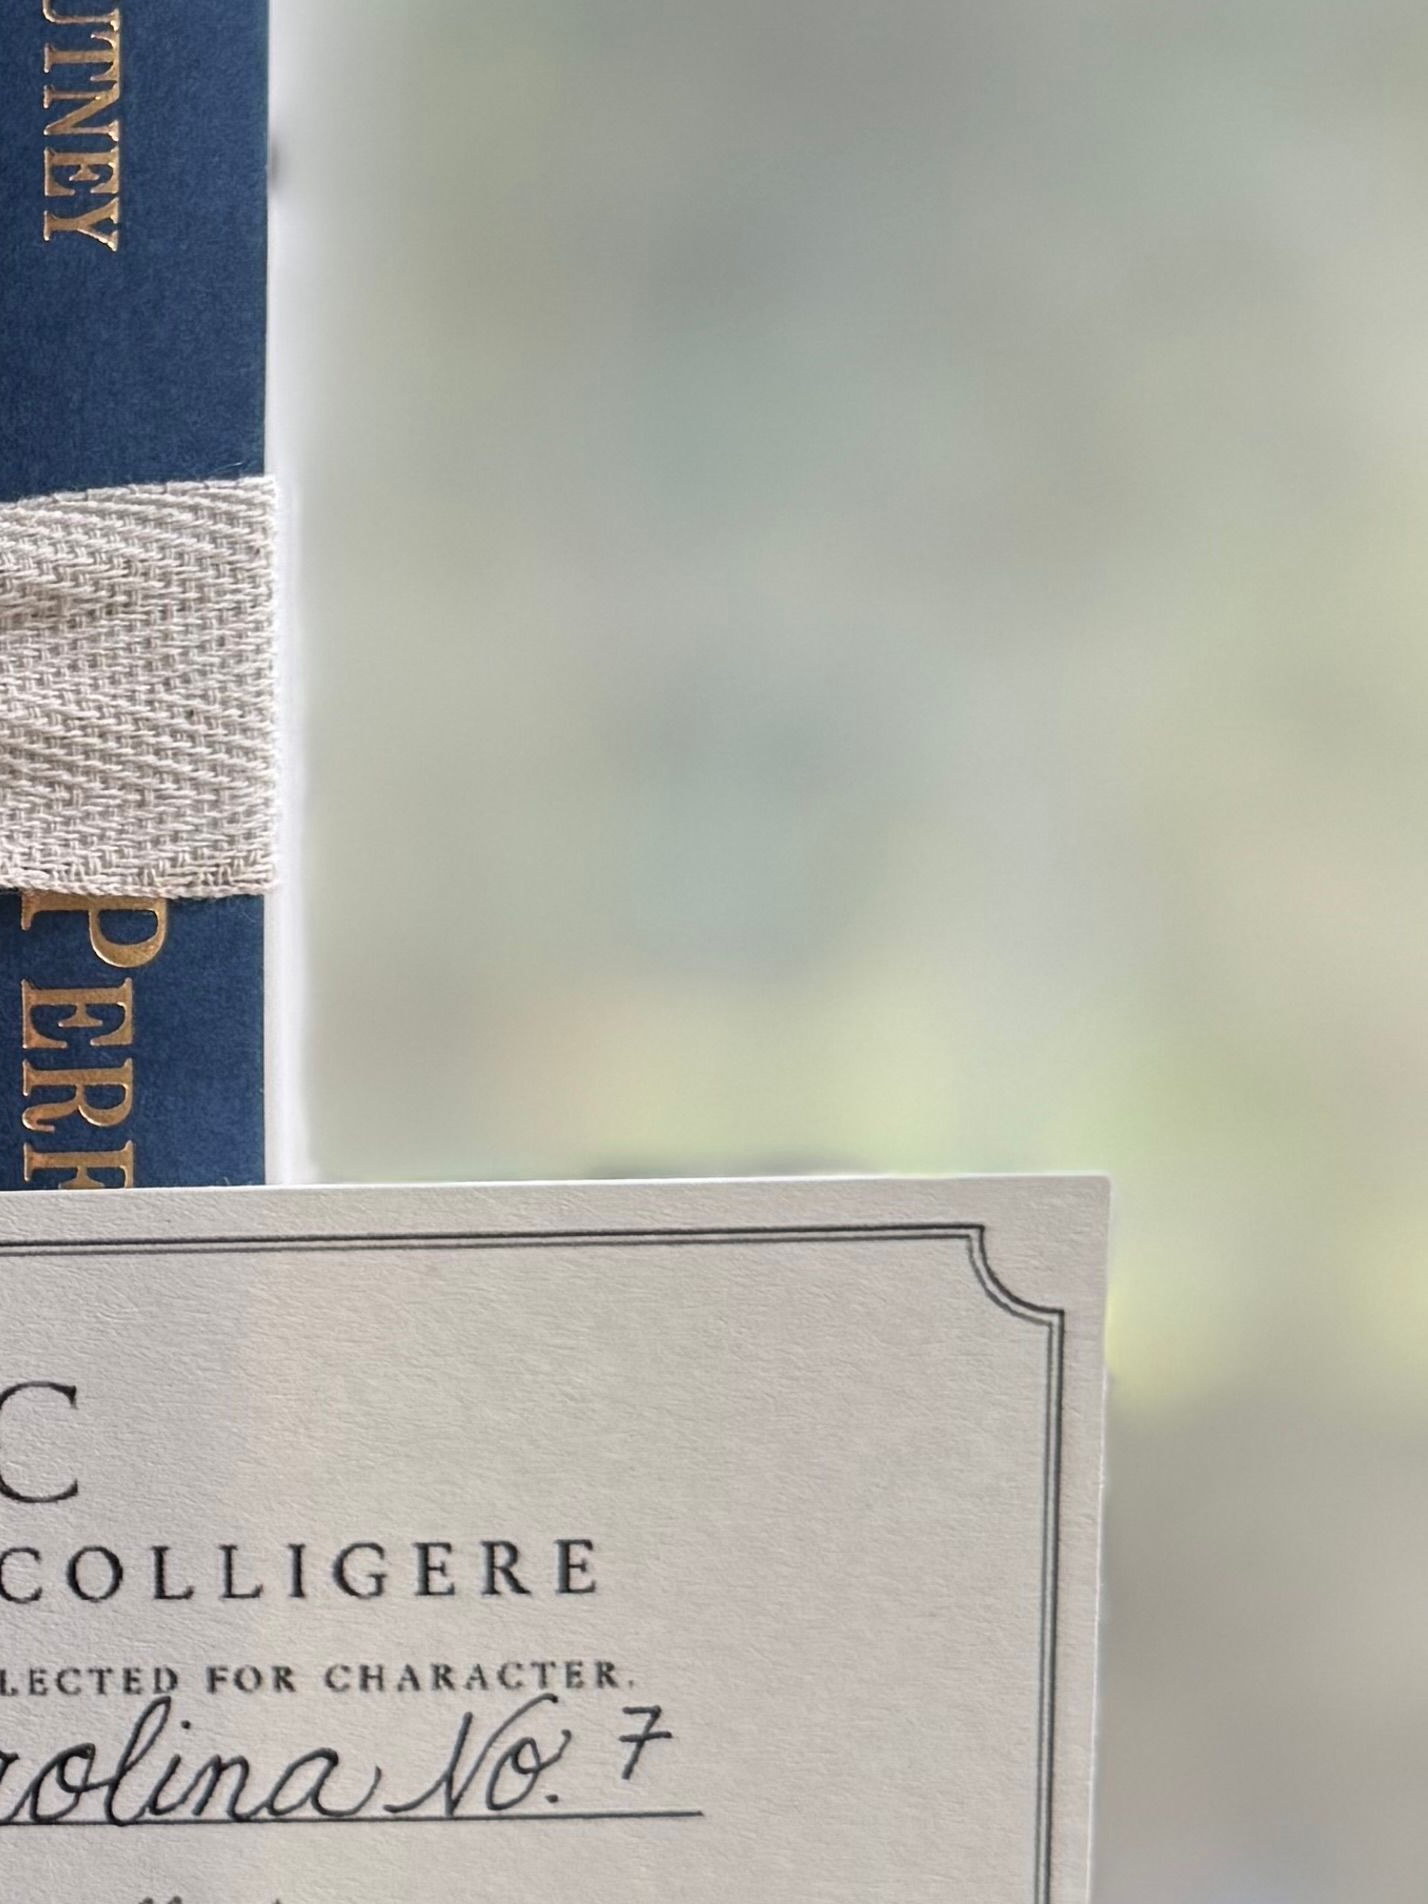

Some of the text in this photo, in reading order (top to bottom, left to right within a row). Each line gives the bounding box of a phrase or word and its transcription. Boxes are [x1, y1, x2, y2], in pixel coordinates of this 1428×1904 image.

[205, 1663, 297, 1694] FOR
[324, 1659, 638, 1692] CHARACTER.
[383, 1692, 573, 1818] No.
[617, 1705, 673, 1780] 7
